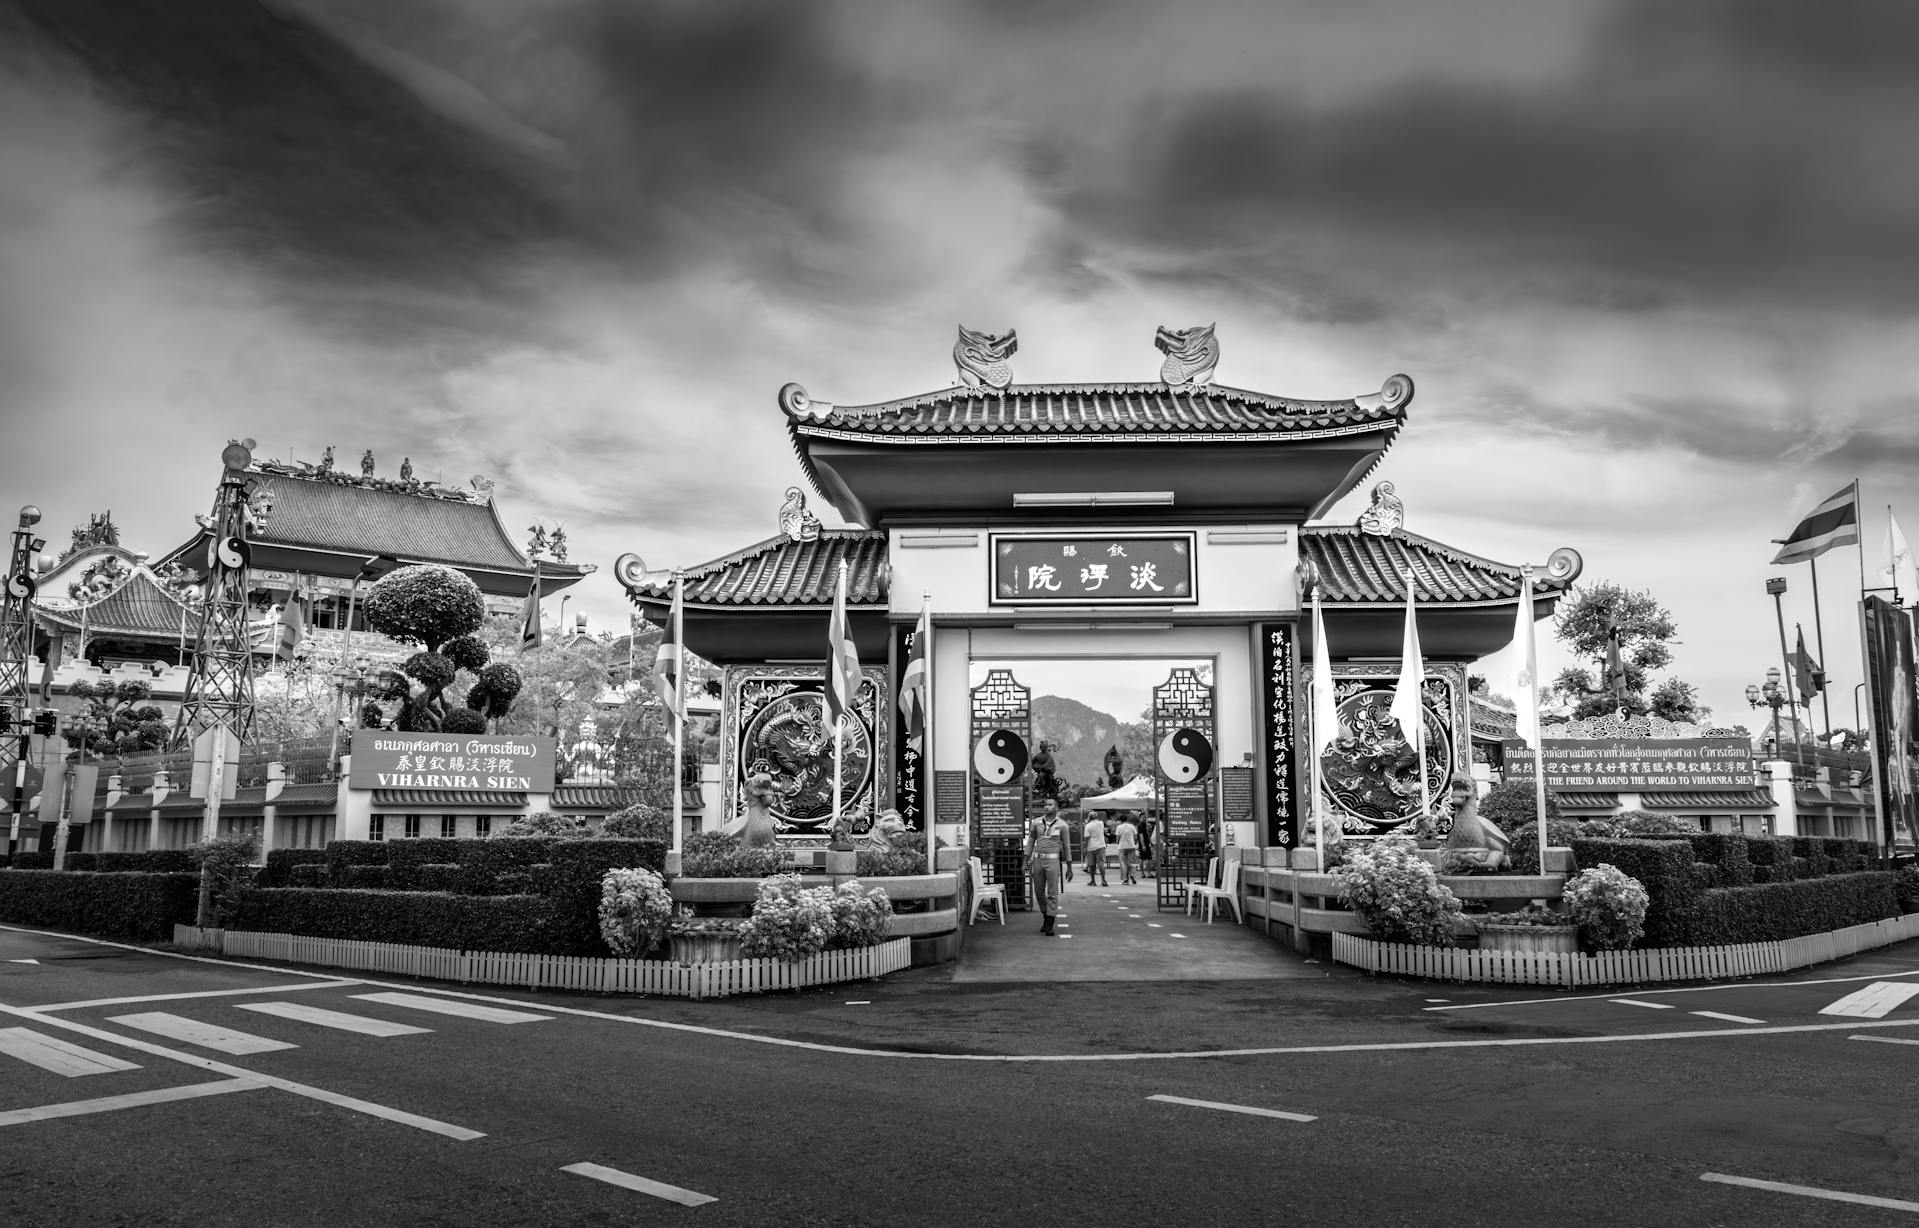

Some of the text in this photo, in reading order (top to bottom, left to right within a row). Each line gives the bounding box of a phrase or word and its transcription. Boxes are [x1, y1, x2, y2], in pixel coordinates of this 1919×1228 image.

[374, 739, 459, 756] อเนกกุศลศาลา
[395, 755, 514, 774] 泰皇欽賜淡浮院
[377, 773, 532, 790] VIHARNRA SIEN
[1548, 776, 1564, 786] THE
[1566, 776, 1595, 786] FRIEND
[1596, 776, 1629, 786] AROUND
[1630, 776, 1646, 785] THE
[1647, 776, 1677, 785] WORLD
[1679, 776, 1690, 785] TO
[1691, 776, 1733, 785] VIHARNRA
[1735, 776, 1753, 785] SIEN
